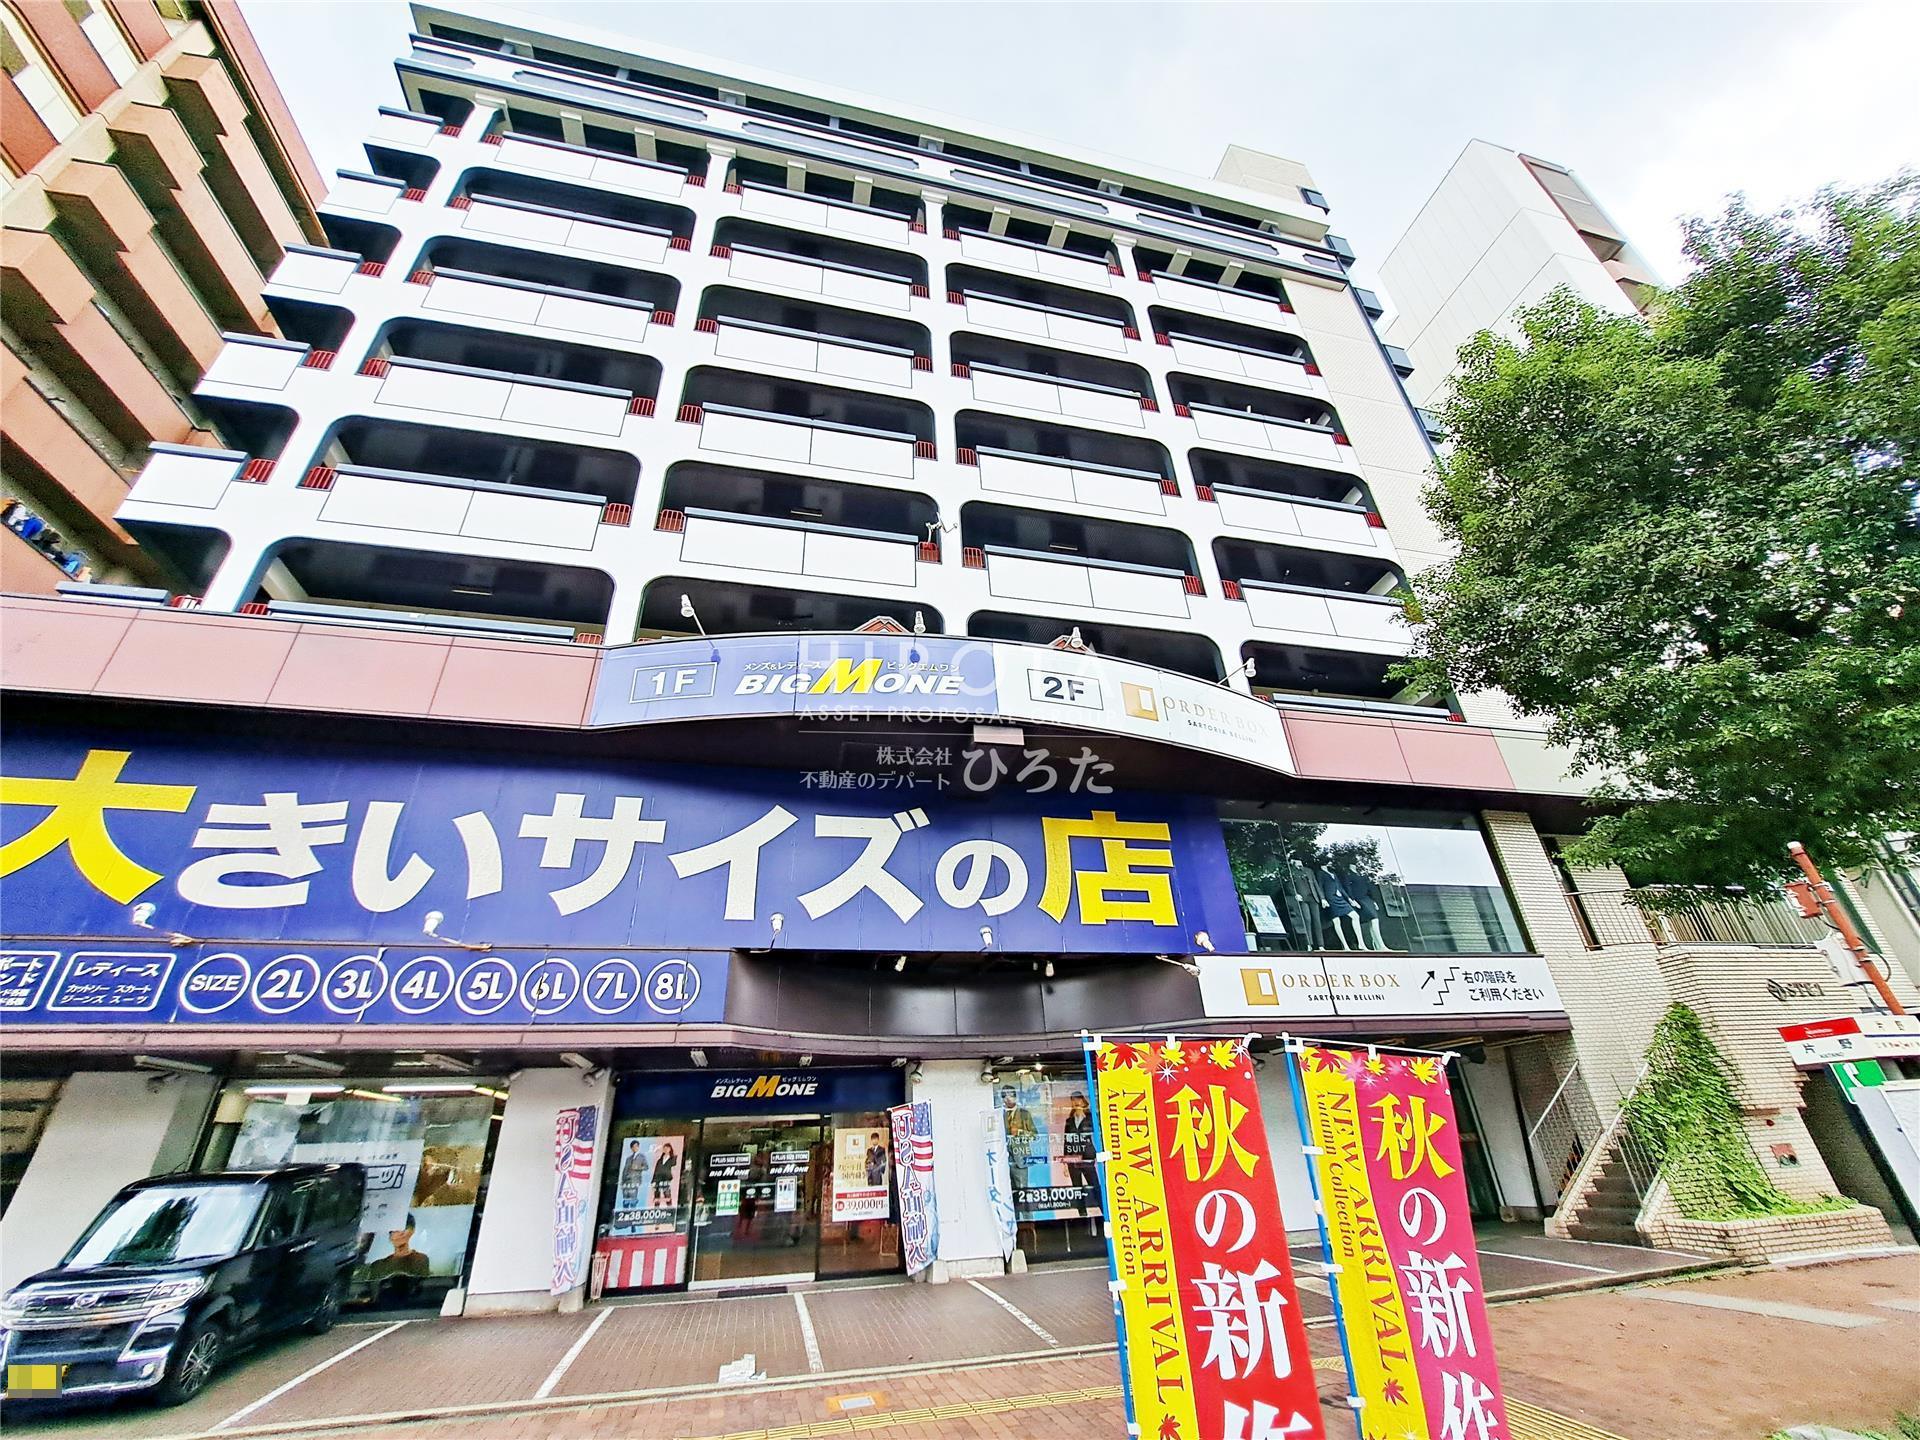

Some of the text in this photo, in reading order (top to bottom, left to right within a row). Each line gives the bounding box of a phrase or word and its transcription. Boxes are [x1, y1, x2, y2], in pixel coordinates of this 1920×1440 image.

[886, 660, 960, 673] ビッグエムワン
[651, 668, 698, 696] 1F
[1043, 676, 1085, 702] 2F
[0, 748, 1180, 926] 大きいサイズの店
[73, 962, 161, 978] レディース
[1461, 970, 1517, 985] 右の階段を
[66, 984, 153, 994] カットソー スカート
[190, 968, 690, 1000] SIZE 2L 3L 4L 5L 6L 7L 8L
[1281, 973, 1401, 989] ORDER BOX
[60, 994, 149, 1004] ジーンズ スーツ
[1308, 993, 1386, 1002] SARTORIA BELLINI
[1468, 987, 1545, 1002] ご利用ください
[1106, 1088, 1138, 1276] Autumn Collection
[1329, 1161, 1355, 1259] Collection
[1327, 1090, 1410, 1372] NEW ARRIVAL
[1121, 1089, 1185, 1405] NEW ARRIVAL
